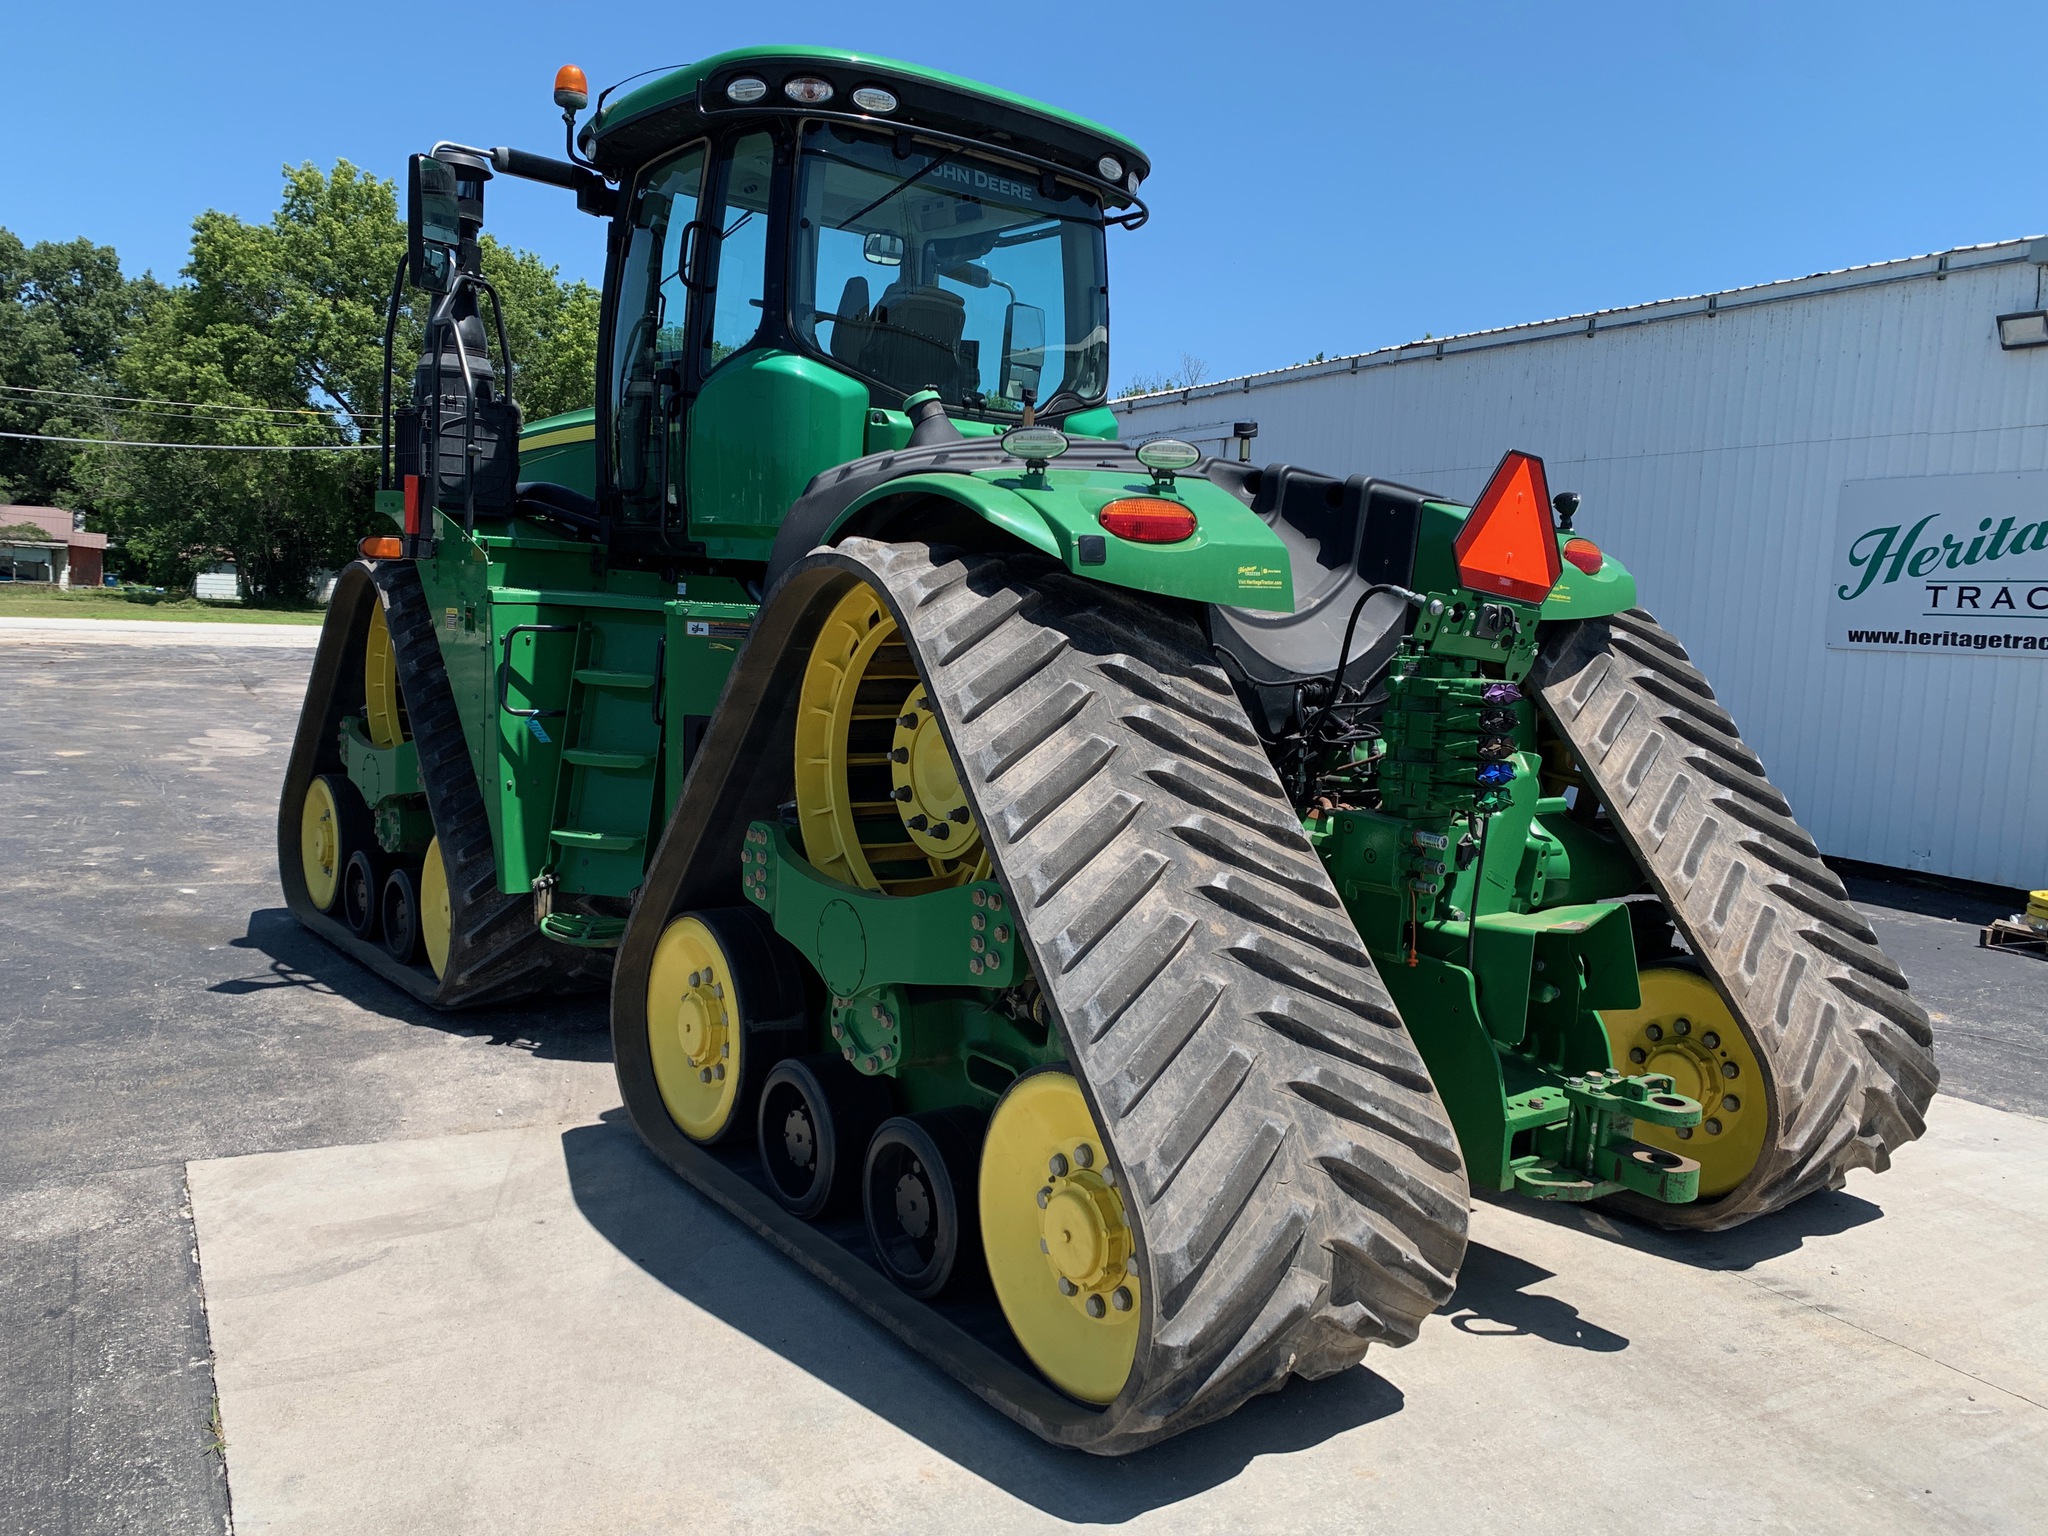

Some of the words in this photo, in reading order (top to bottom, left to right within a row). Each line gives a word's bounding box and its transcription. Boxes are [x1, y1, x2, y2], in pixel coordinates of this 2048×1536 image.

[974, 170, 1033, 201] DEERE
[1838, 512, 2048, 600] Herita
[1926, 585, 2048, 610] TRAC
[1848, 629, 2048, 650] www.heritagetrac
